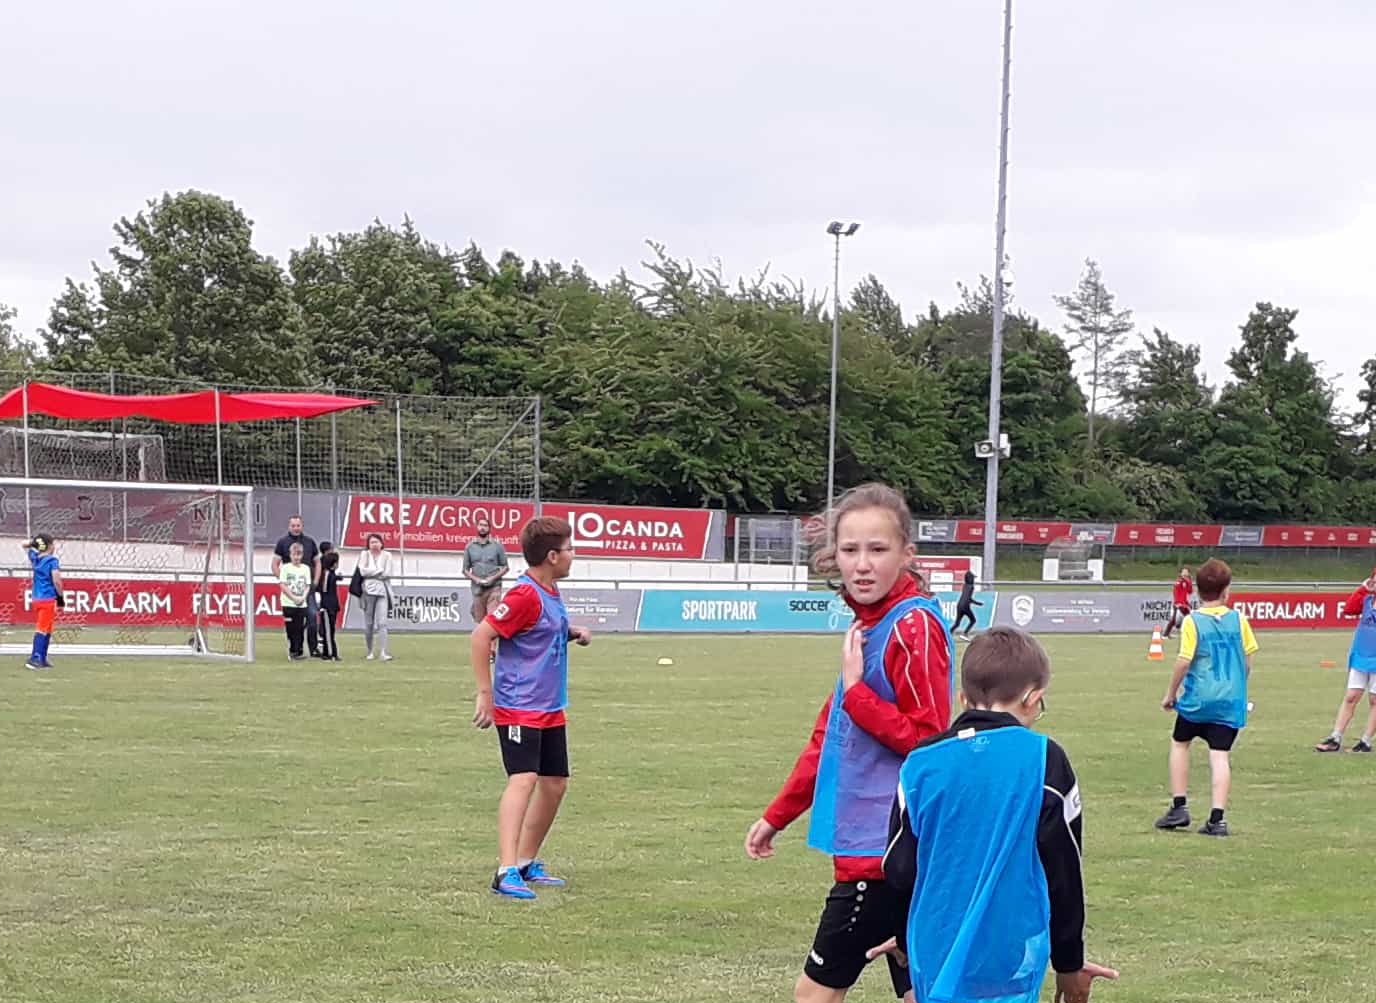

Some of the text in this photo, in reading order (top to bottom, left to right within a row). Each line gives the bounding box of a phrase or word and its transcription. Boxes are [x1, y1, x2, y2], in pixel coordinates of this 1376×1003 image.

[605, 540, 636, 550] PIZZA
[652, 542, 684, 552] PASTA
[24, 590, 172, 613] FERALARM
[682, 600, 757, 620] SPORTPARK
